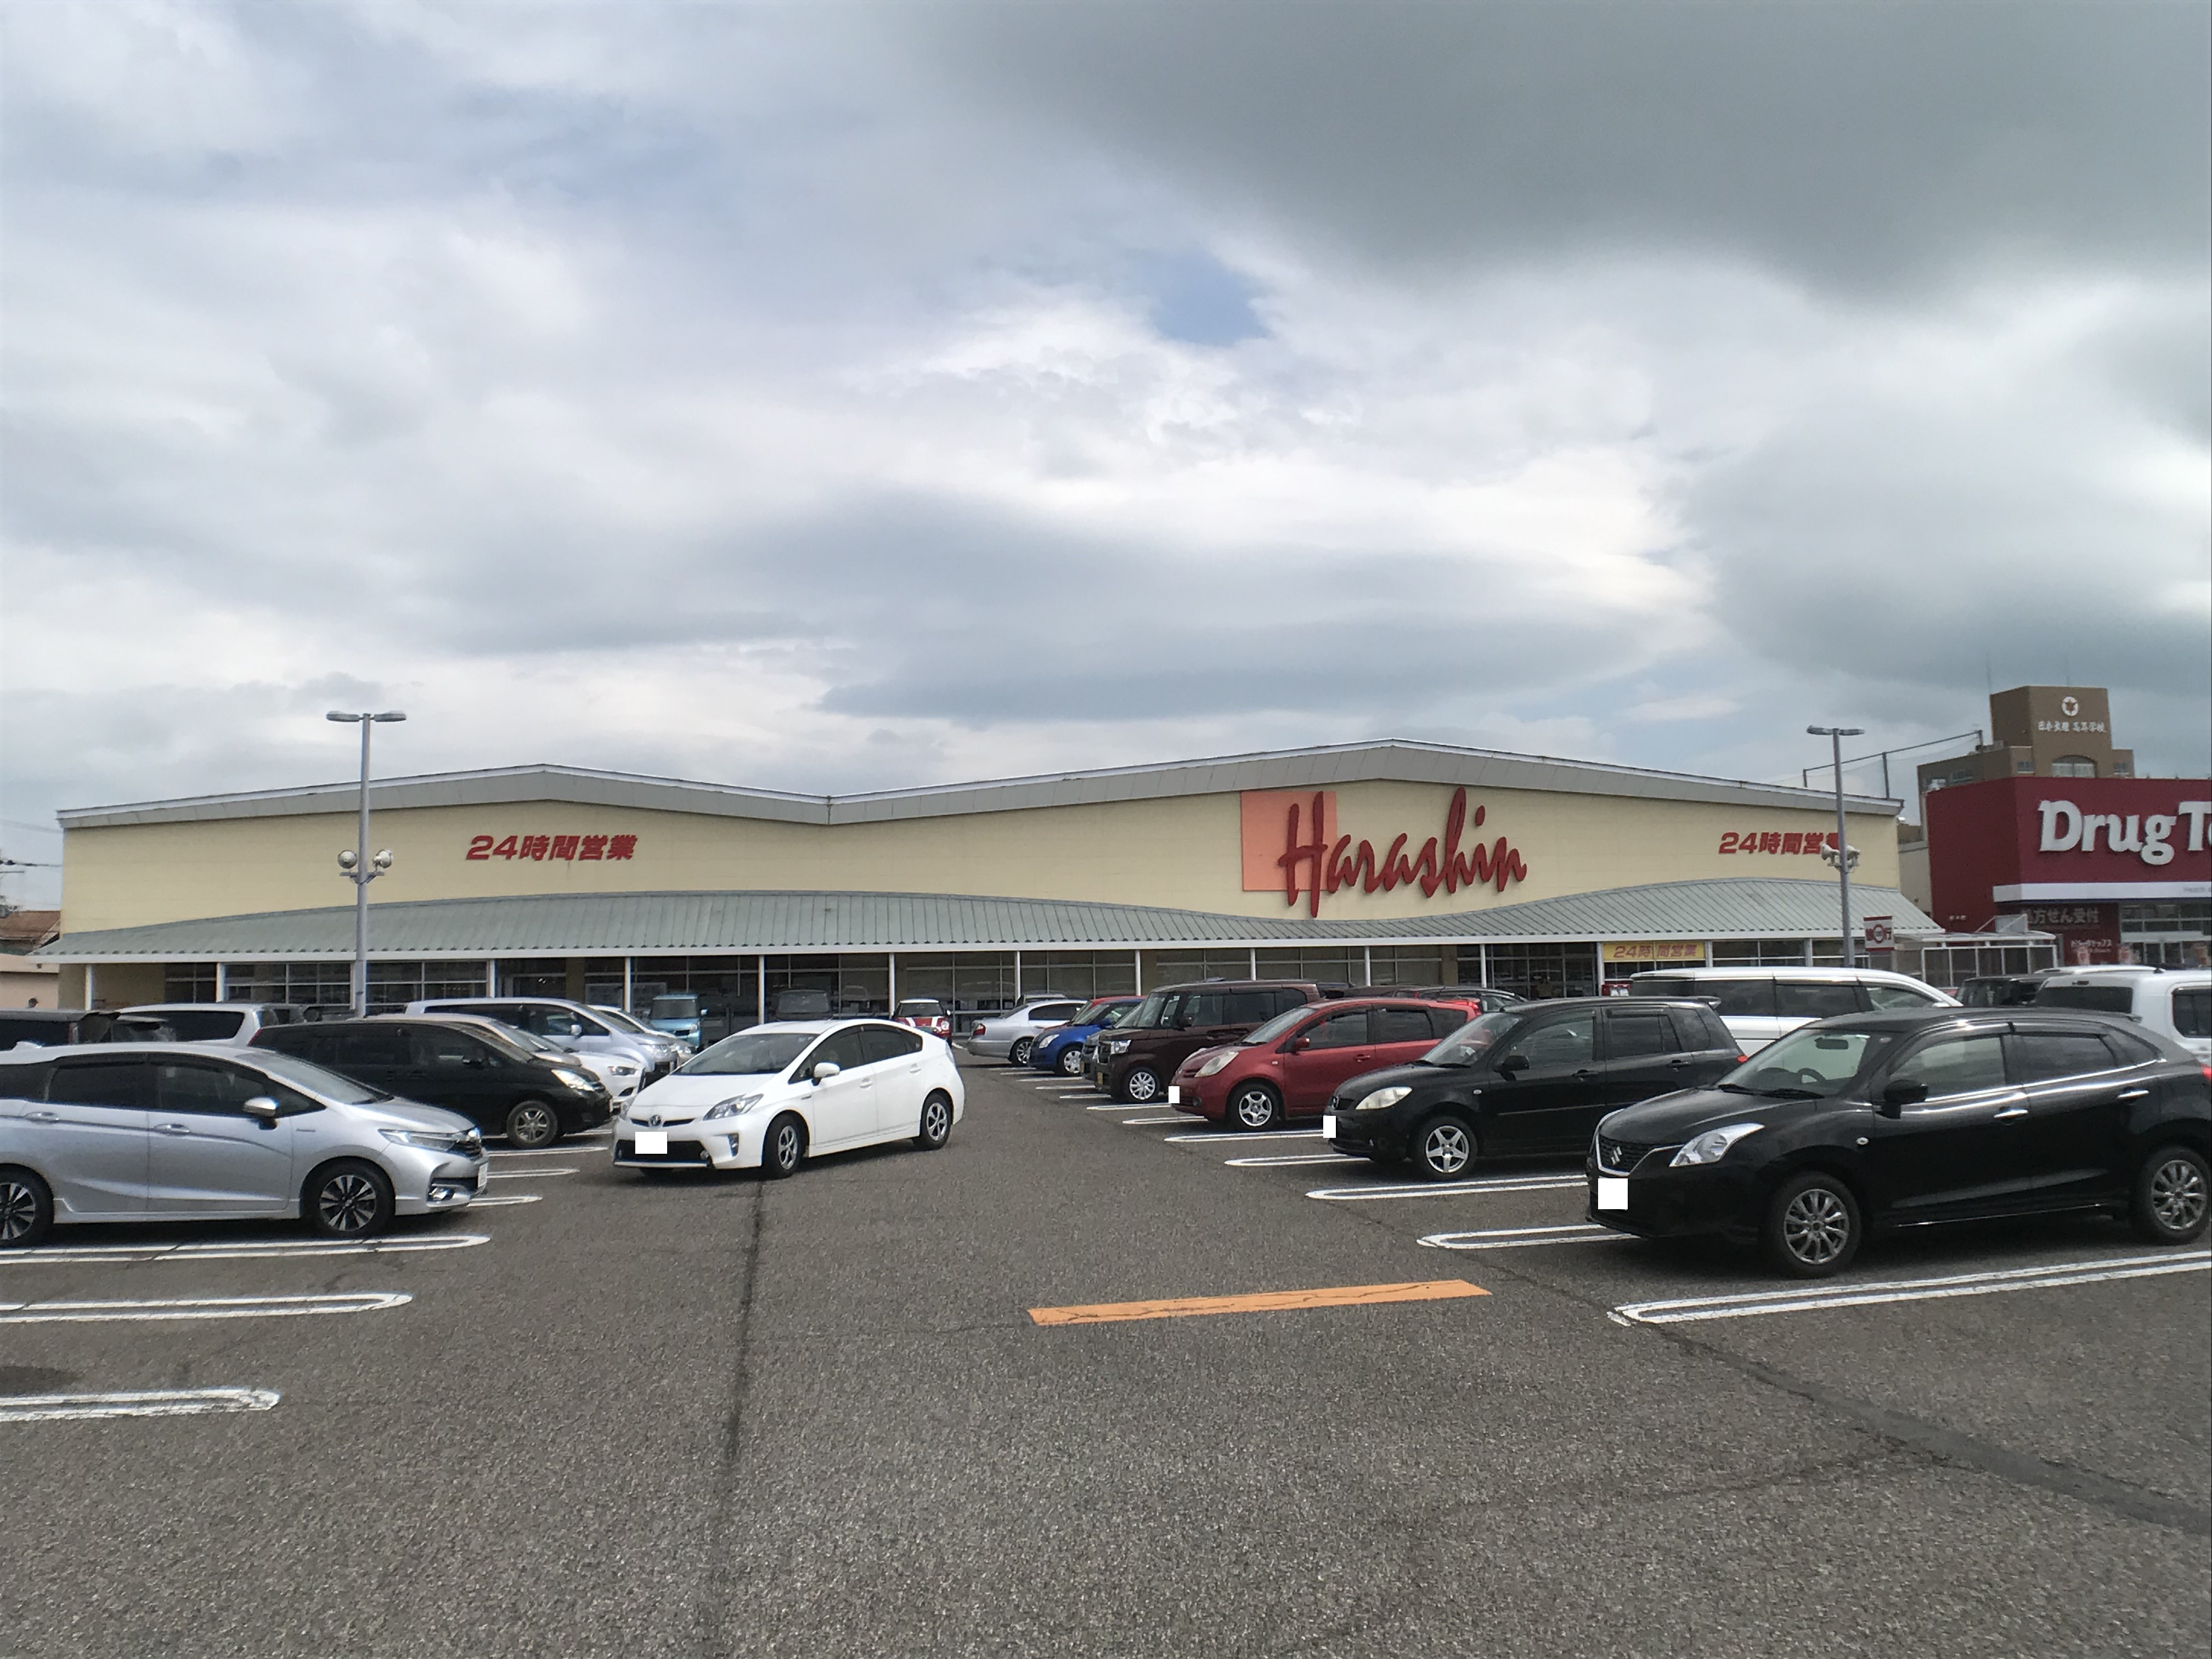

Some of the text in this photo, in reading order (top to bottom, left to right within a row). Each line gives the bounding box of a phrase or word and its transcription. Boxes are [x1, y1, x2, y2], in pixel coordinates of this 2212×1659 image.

[466, 834, 637, 861] 24時間営業
[1277, 786, 1527, 918] Harashin
[2038, 800, 2211, 865] Drug T
[1613, 944, 1697, 958] 24時間営業
